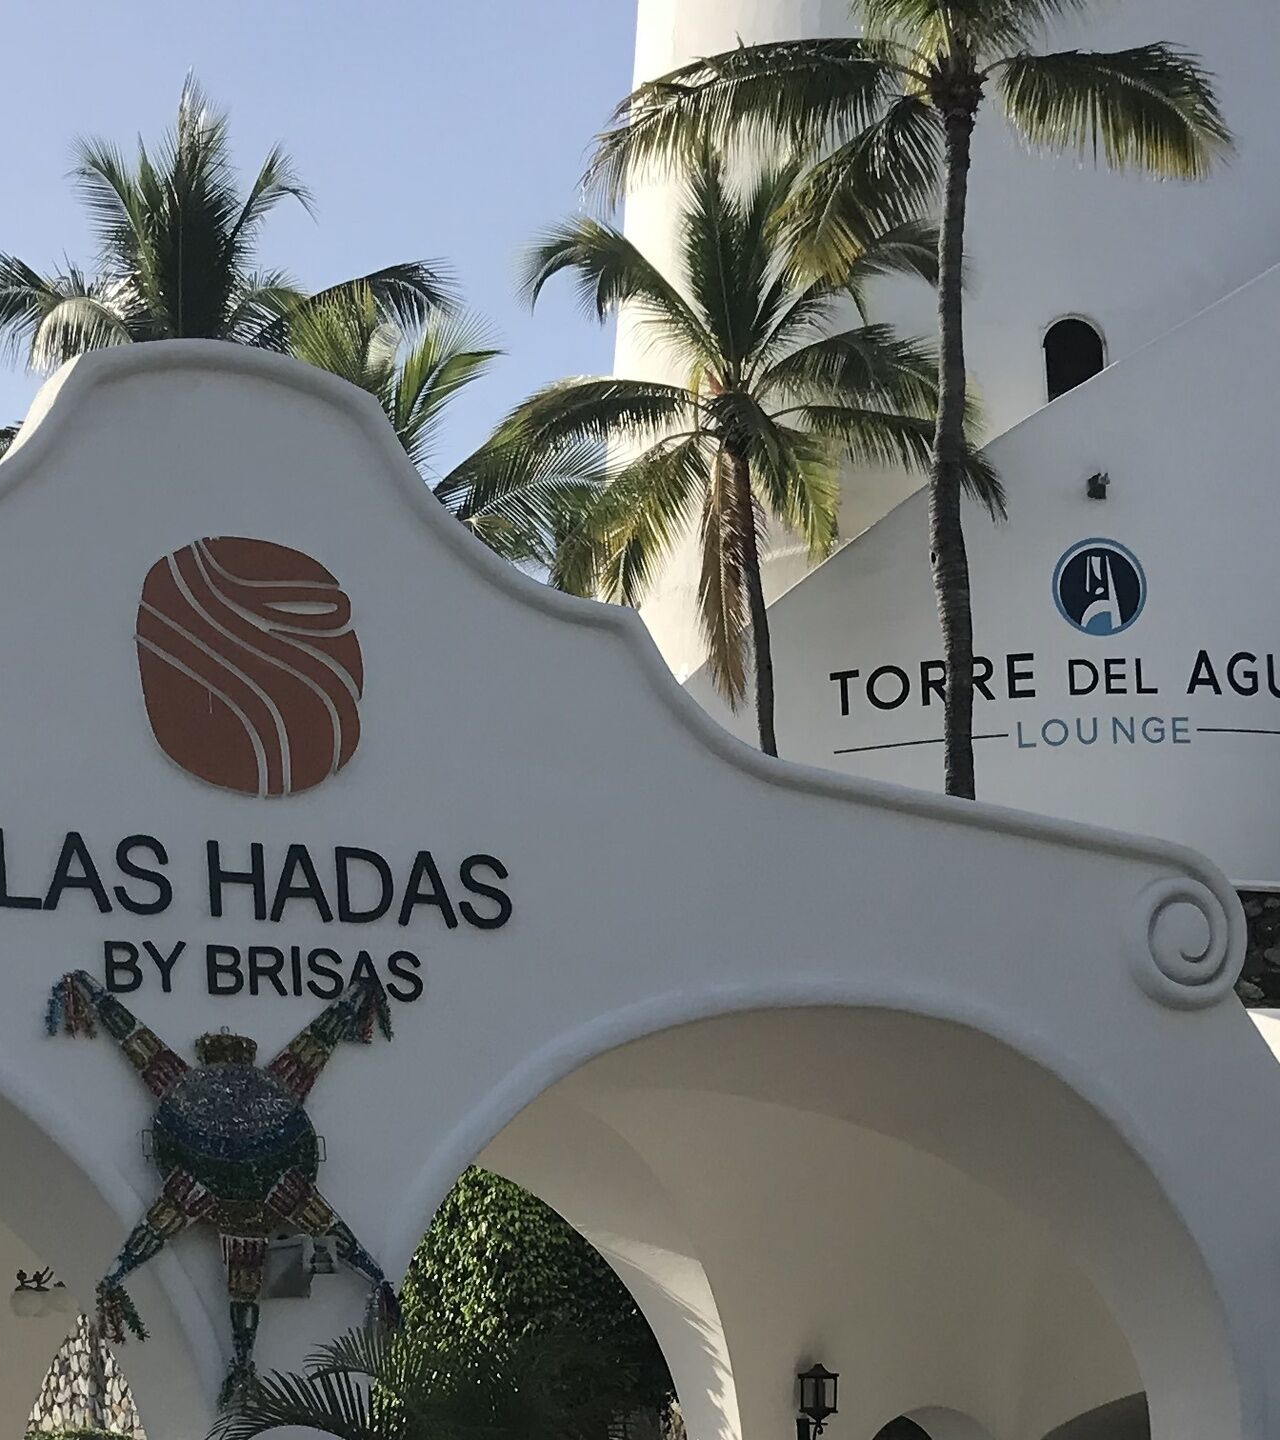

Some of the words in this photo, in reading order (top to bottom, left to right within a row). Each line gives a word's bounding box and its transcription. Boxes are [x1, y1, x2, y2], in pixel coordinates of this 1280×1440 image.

[829, 652, 1036, 716] TORRE
[1067, 657, 1158, 696] DEL
[1016, 715, 1192, 750] LOUNGE
[206, 839, 513, 930] HADAS
[104, 940, 186, 993] BY
[206, 943, 424, 1003] BRISAS
